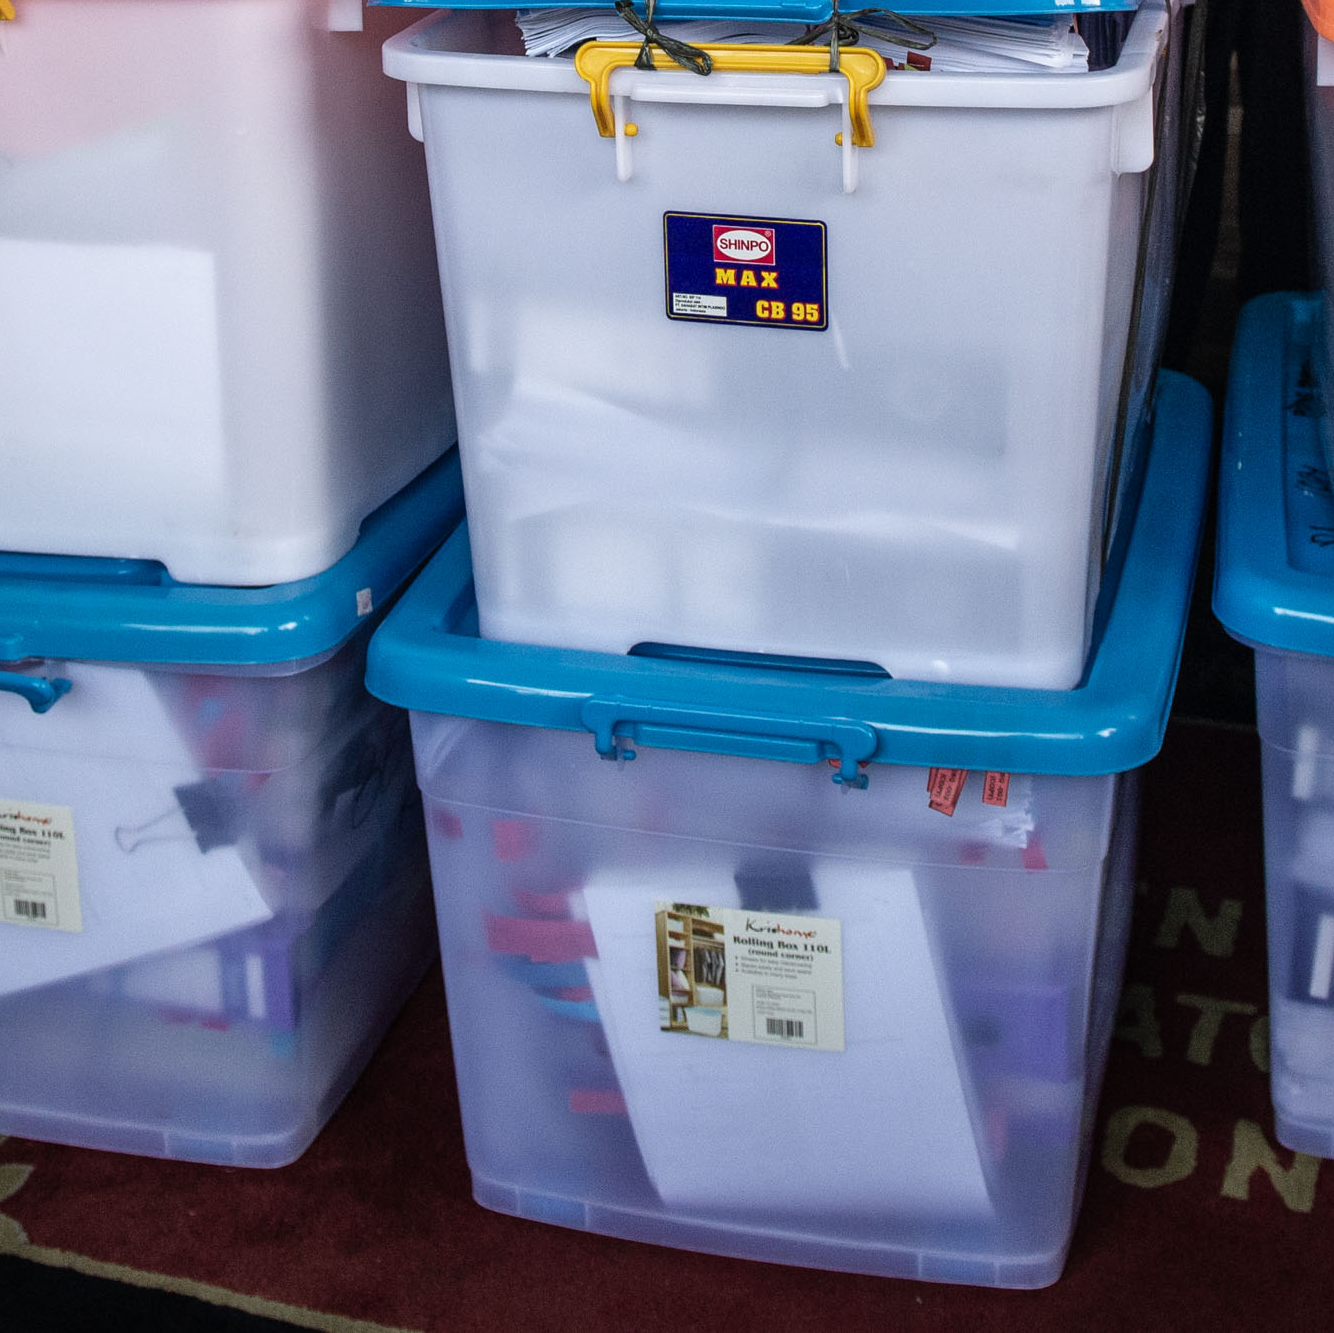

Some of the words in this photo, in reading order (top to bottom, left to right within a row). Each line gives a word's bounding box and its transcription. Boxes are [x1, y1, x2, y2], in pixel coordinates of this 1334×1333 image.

[719, 237, 770, 253] SHINPO
[715, 268, 779, 289] MAX
[755, 299, 786, 320] CB
[791, 301, 820, 323] 95
[19, 827, 37, 837] Box
[733, 935, 774, 951] Rolling
[777, 940, 799, 952] Box
[803, 942, 832, 955] 110L
[747, 948, 779, 958] (round
[781, 952, 814, 963] corner)
[1117, 983, 1271, 1075] AT
